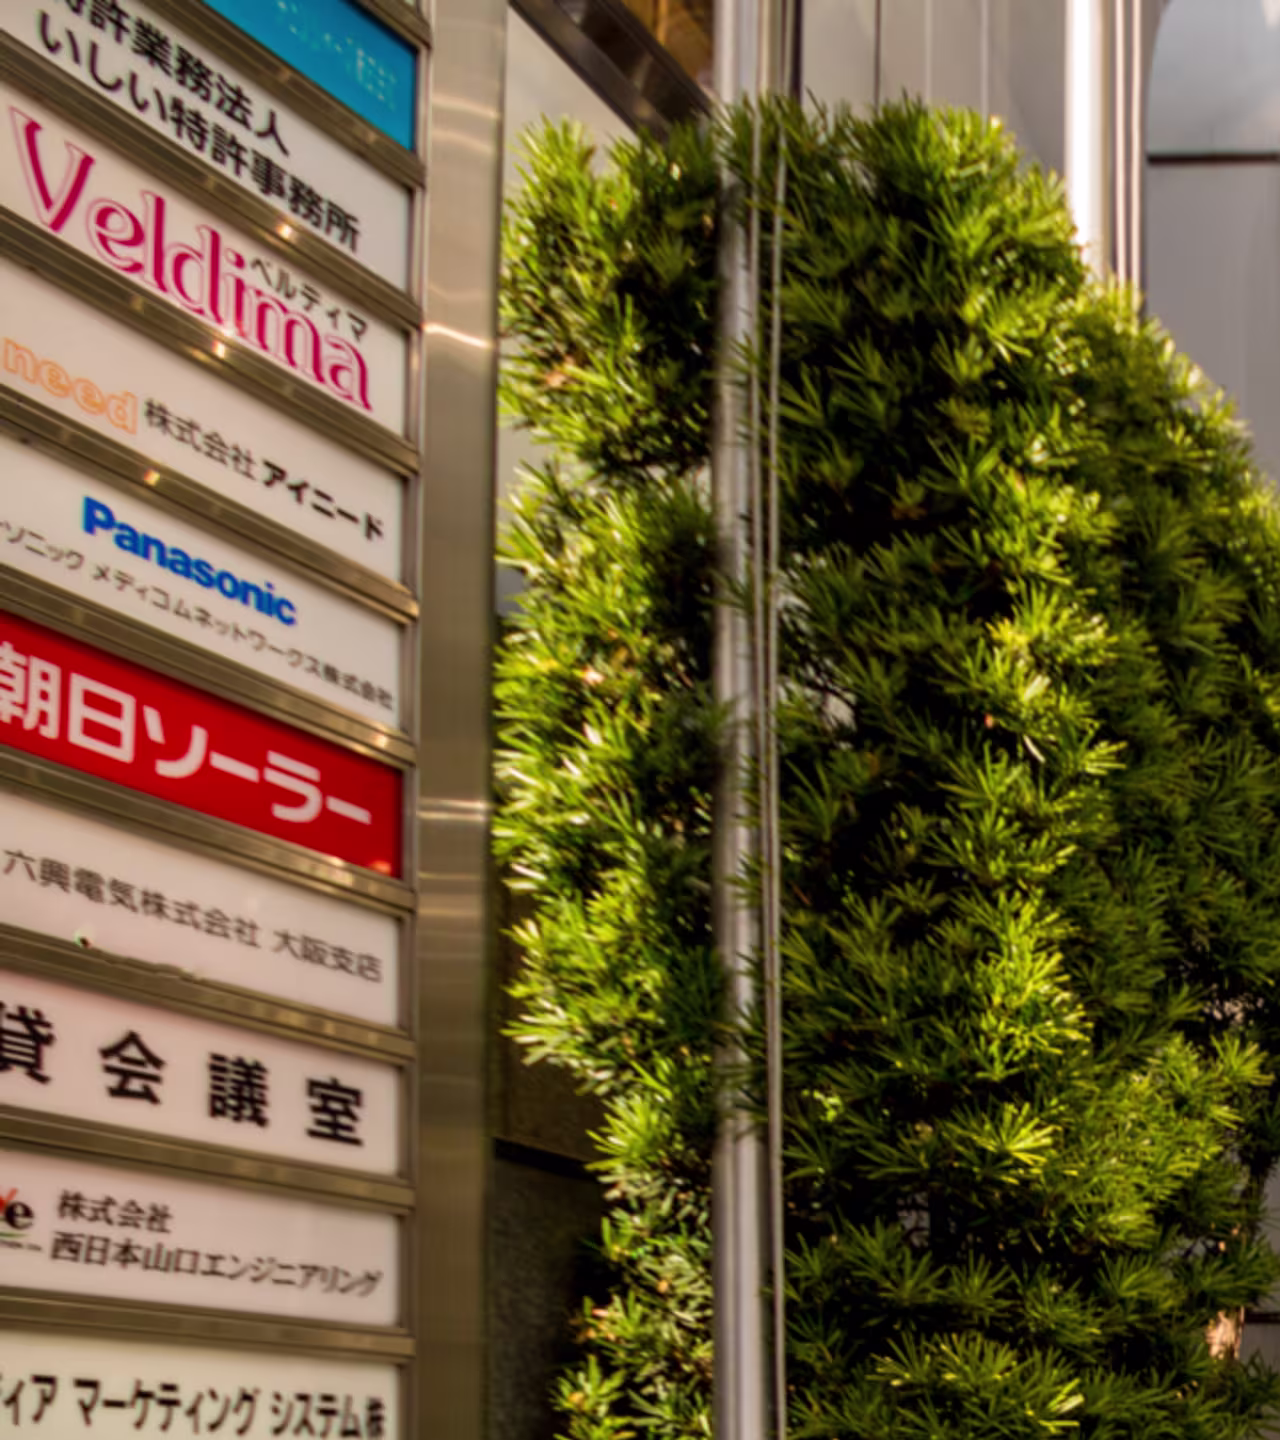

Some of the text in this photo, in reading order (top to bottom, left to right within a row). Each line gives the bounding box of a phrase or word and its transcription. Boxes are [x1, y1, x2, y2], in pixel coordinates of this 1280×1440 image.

[35, 8, 361, 252] いしい特許事務所
[8, 106, 373, 412] Veldima
[250, 254, 368, 340] ベルティマ
[82, 496, 297, 627] Panasonic
[0, 640, 372, 825] 朝日ソーラー
[273, 926, 384, 984] 大阪支店
[0, 1000, 365, 1149] 貸会議室
[50, 1230, 383, 1298] 西日本山口エンジニアリング
[56, 1189, 173, 1234] 株式会社
